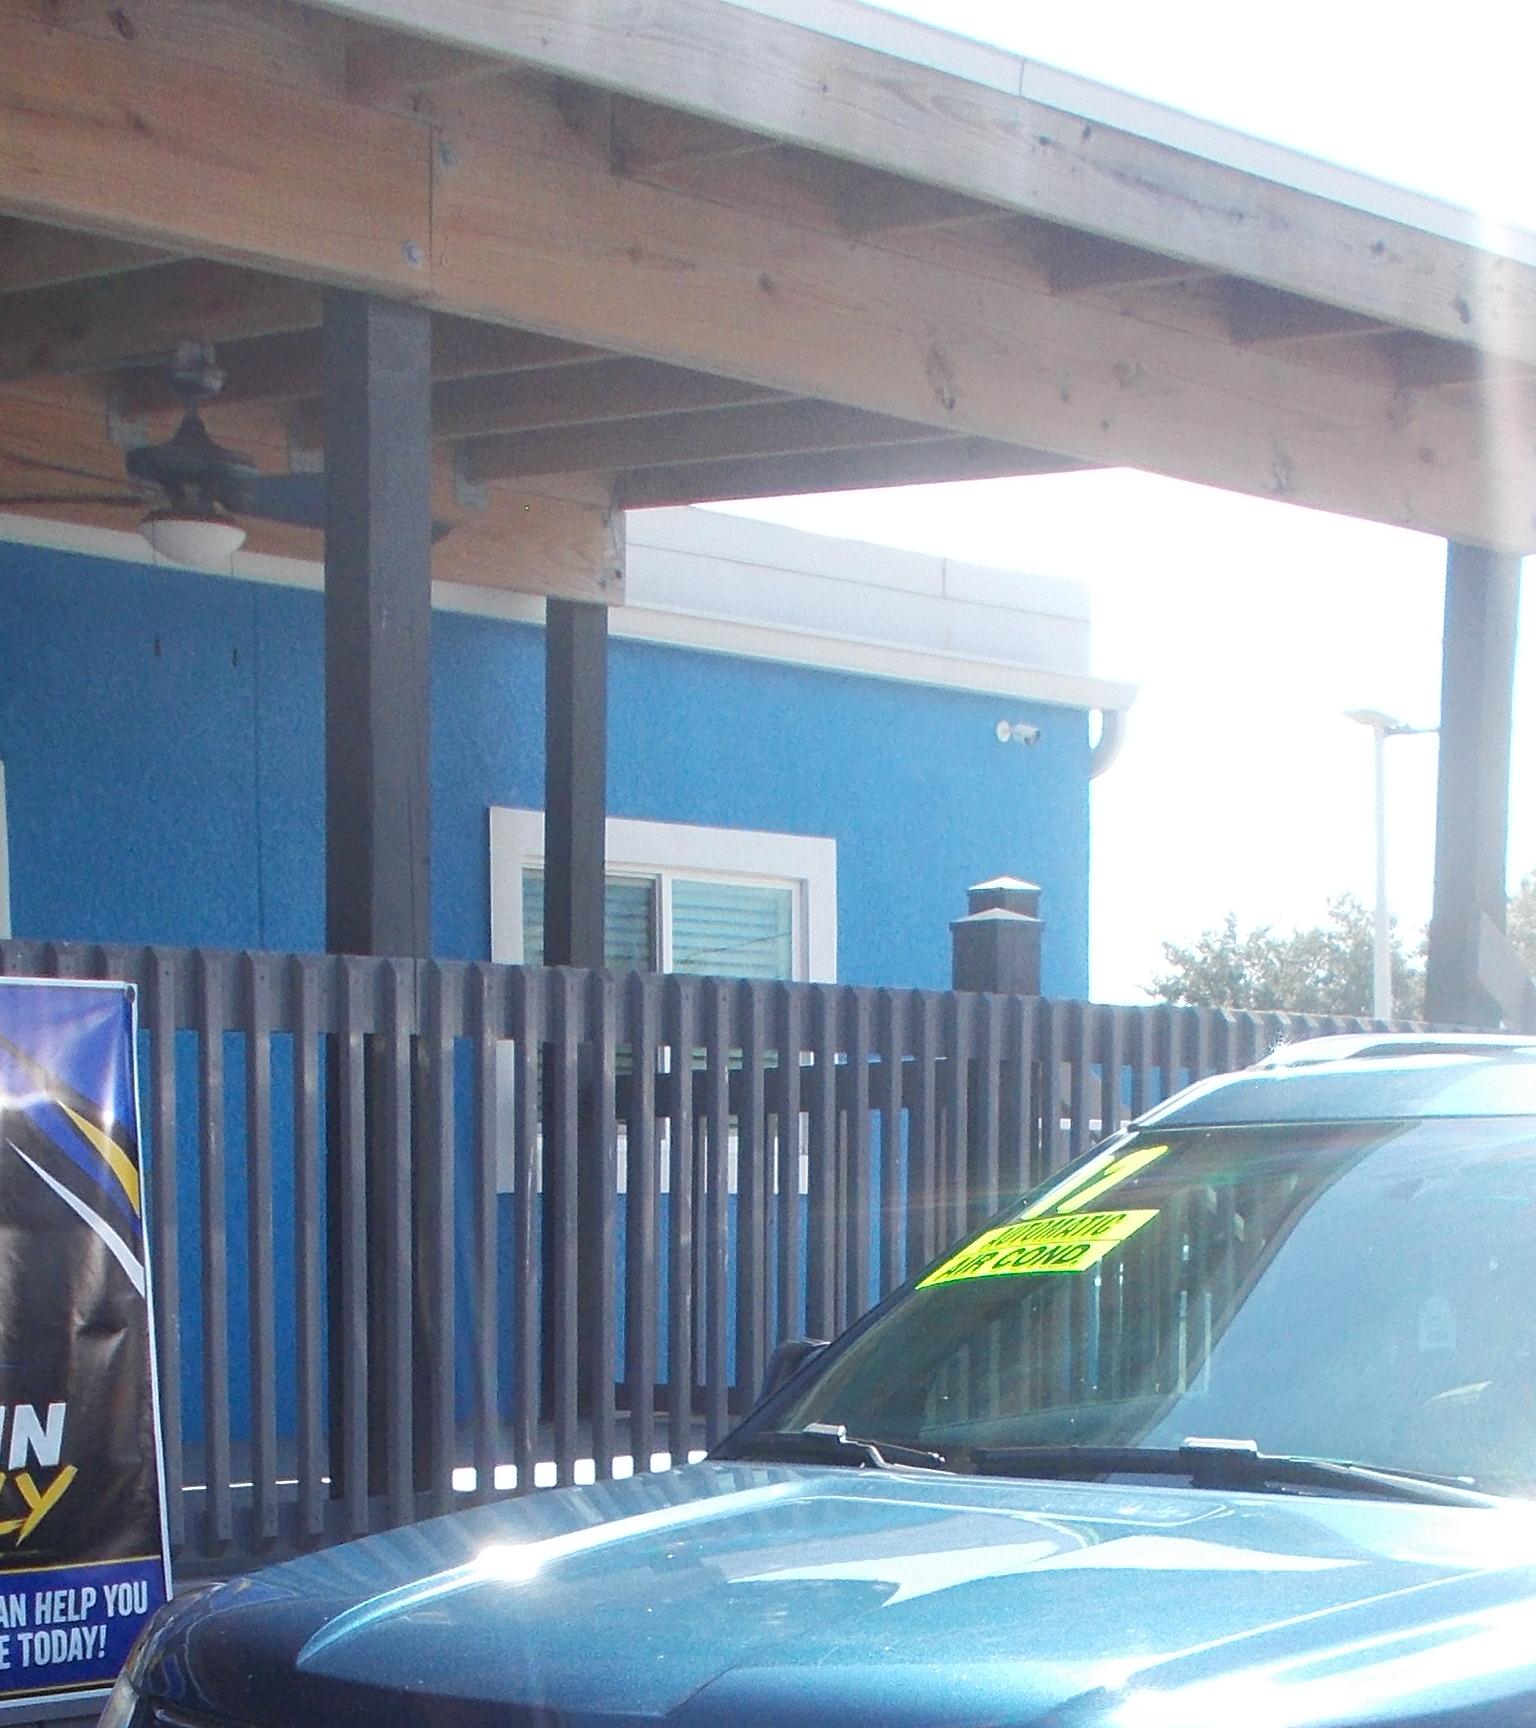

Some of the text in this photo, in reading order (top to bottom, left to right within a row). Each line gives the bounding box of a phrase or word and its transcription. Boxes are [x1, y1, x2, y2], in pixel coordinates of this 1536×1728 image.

[986, 1213, 1127, 1246] AUTOMATIC
[938, 1252, 999, 1279] AIR
[34, 1587, 100, 1627] HELP
[103, 1580, 149, 1617] YOU
[18, 1625, 107, 1667] TODAY!
